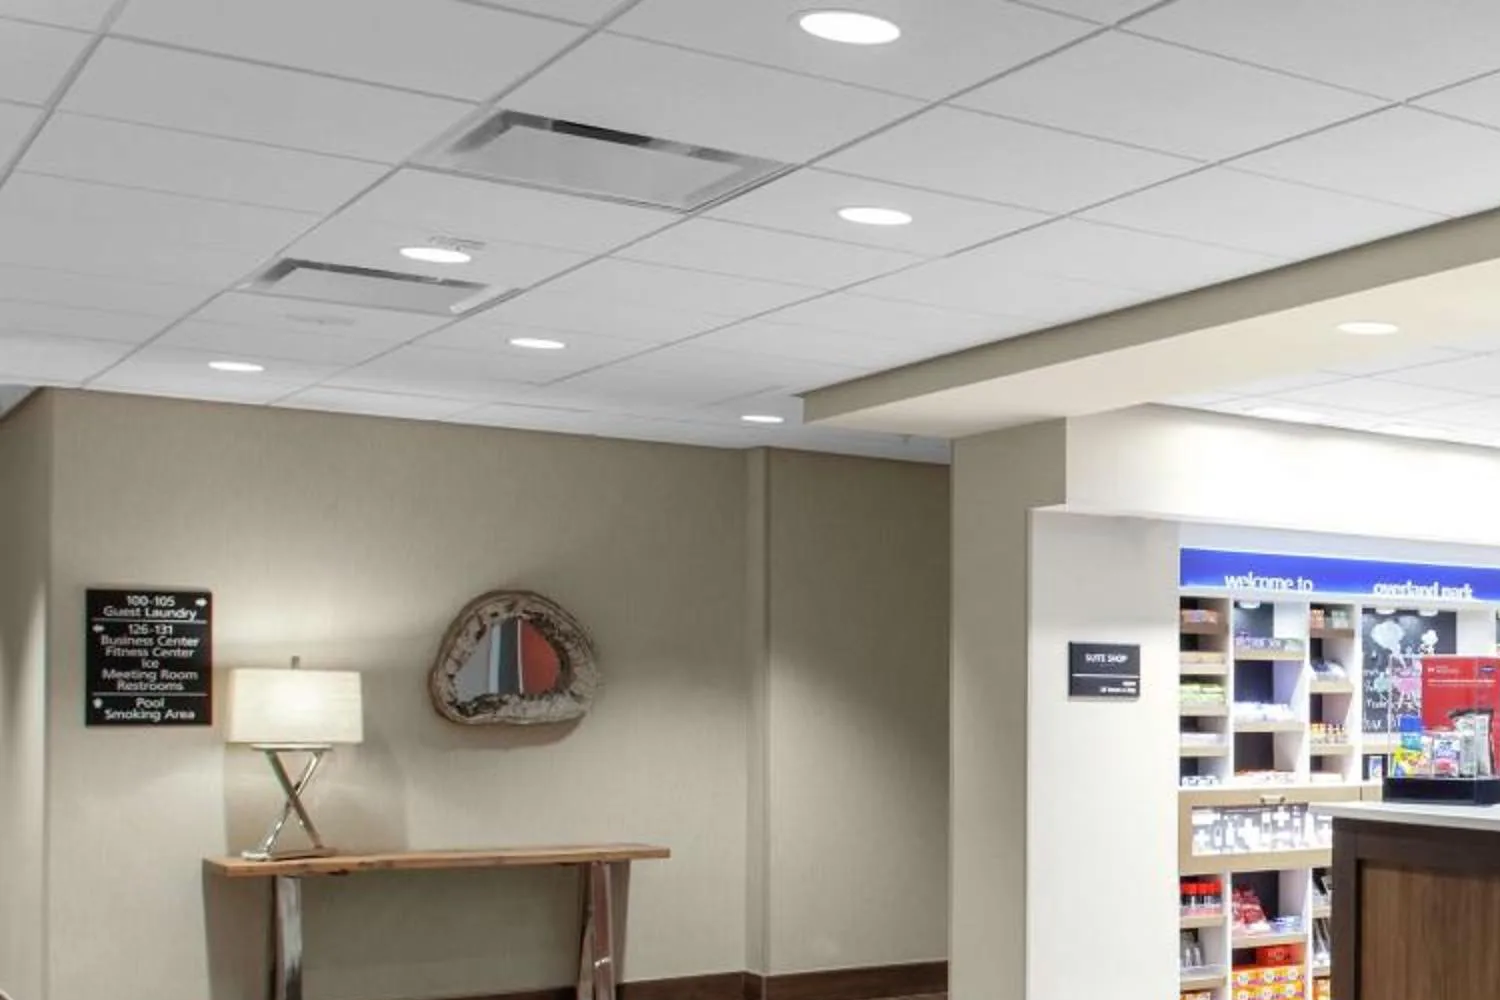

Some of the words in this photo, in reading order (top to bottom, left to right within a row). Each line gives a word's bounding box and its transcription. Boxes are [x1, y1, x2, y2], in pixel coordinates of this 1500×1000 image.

[1224, 571, 1294, 591] welcome
[1297, 576, 1313, 592] to
[103, 605, 141, 617] Guest
[145, 606, 197, 621] Laundry
[101, 635, 154, 646] Business
[157, 636, 200, 647] Center
[105, 646, 149, 657] Fitness
[152, 647, 195, 658] Center
[141, 658, 160, 669] Ice
[102, 669, 157, 682] Meeting
[161, 669, 199, 680] Room
[117, 680, 185, 691] Restrooms
[135, 697, 165, 708] Pool
[105, 709, 161, 722] Smoking
[164, 709, 196, 719] Area
